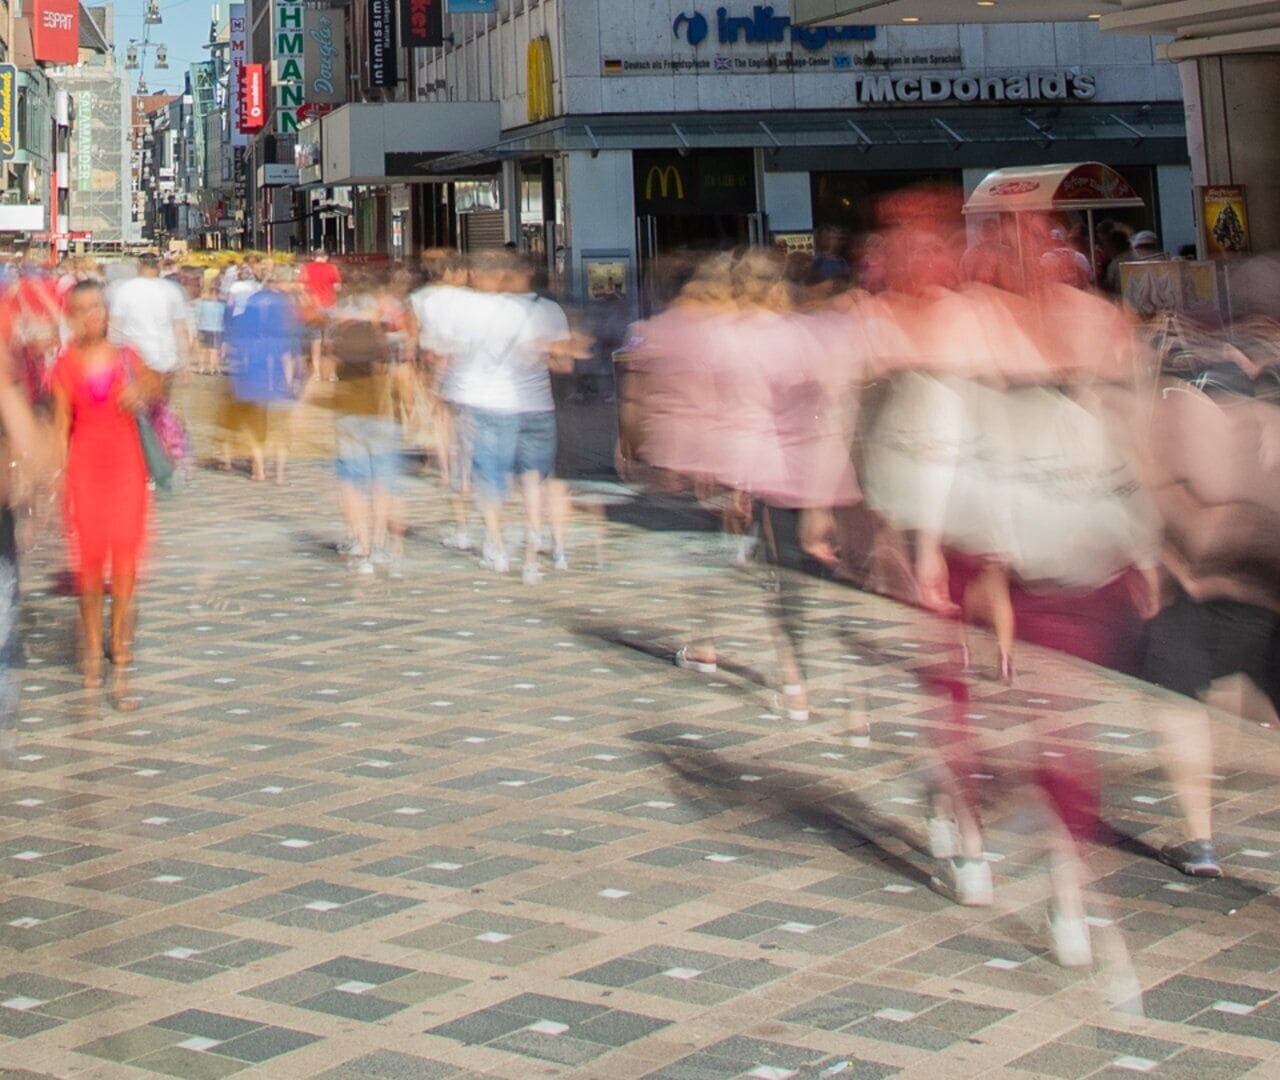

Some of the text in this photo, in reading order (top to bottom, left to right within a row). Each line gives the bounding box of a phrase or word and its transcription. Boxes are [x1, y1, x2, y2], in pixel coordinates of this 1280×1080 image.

[43, 10, 74, 31] ESPRIT
[858, 73, 1097, 103] McDonald's
[79, 91, 91, 180] SALAMANDER
